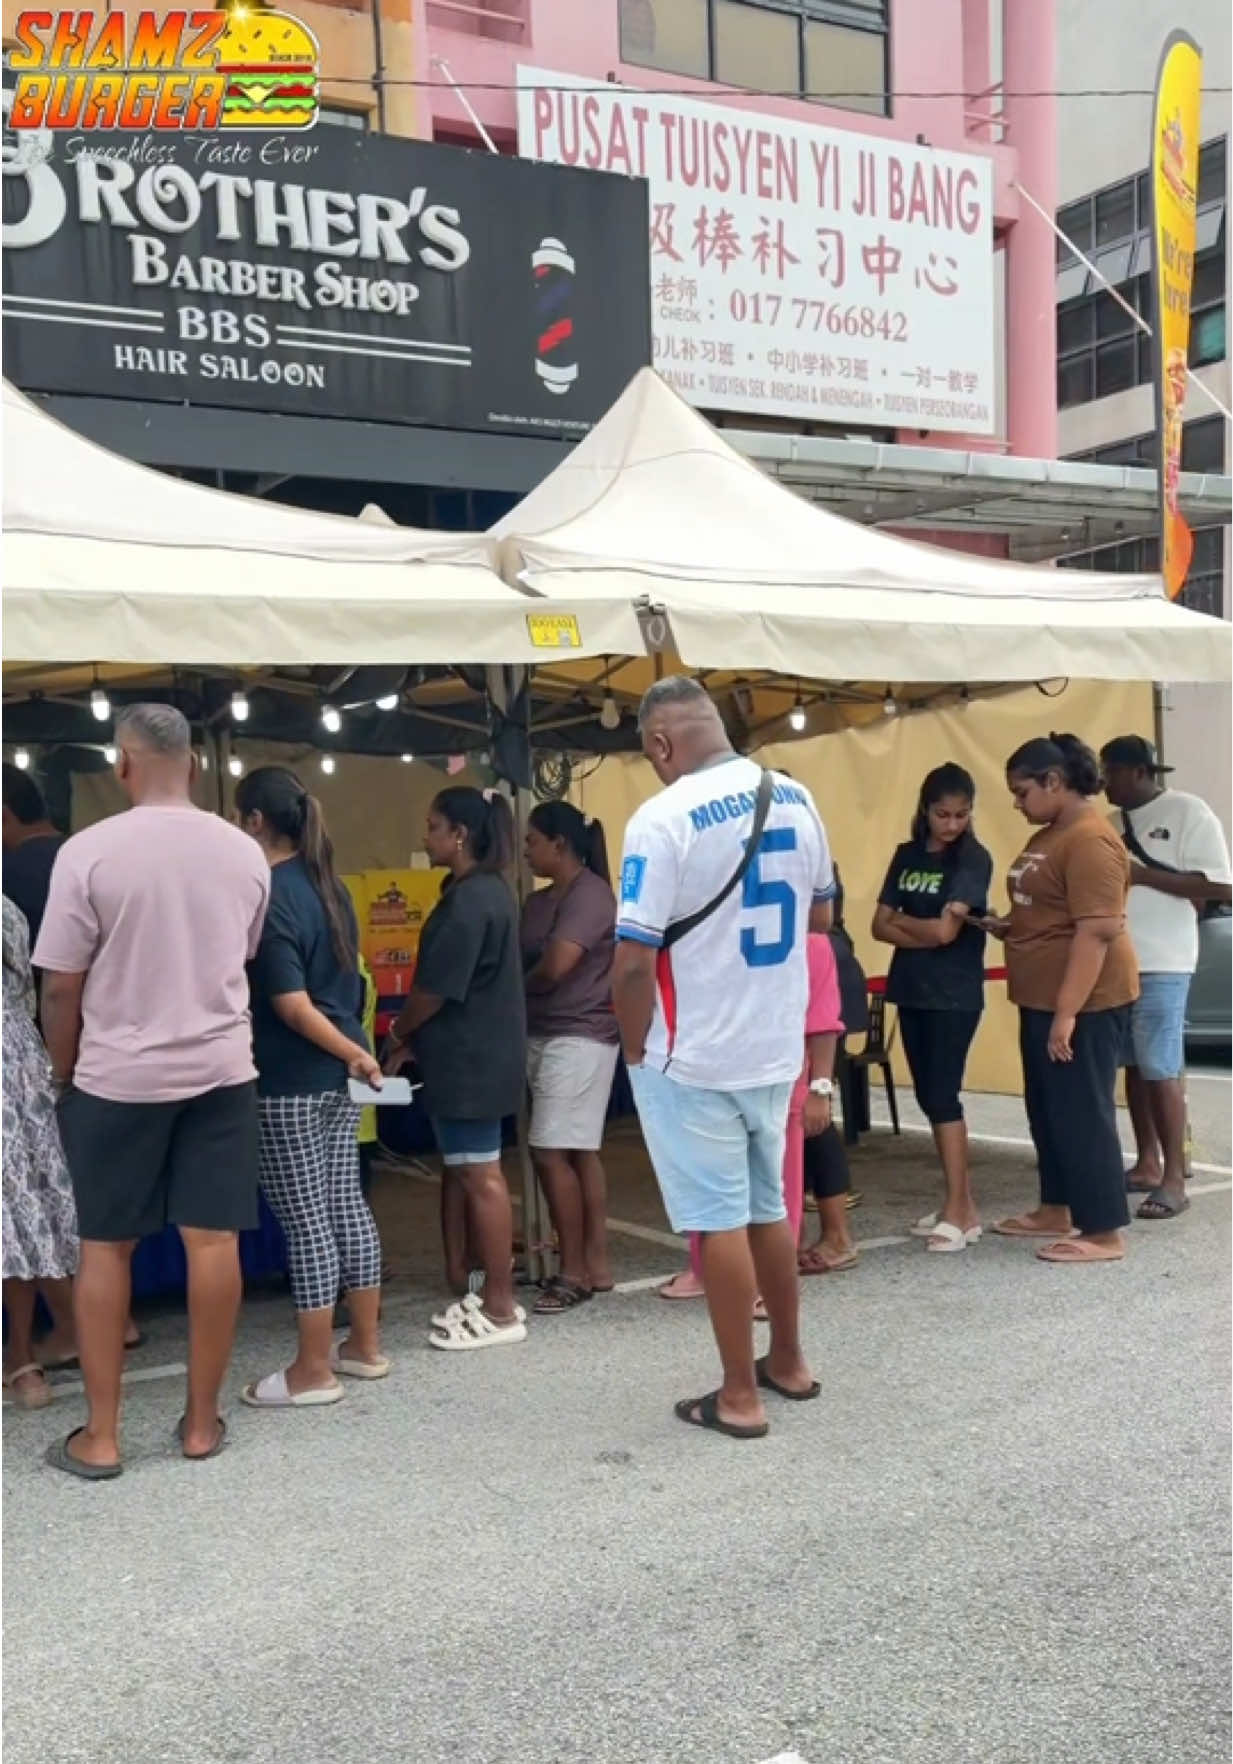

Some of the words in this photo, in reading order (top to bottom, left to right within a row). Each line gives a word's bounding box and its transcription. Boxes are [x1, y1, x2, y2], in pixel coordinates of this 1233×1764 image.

[534, 87, 649, 175] PUSAT
[659, 111, 799, 204] TUISYEN
[809, 141, 841, 211] YI
[851, 153, 876, 217] JI
[888, 156, 982, 236] BANG
[128, 234, 314, 309] BARBER
[314, 261, 419, 315] SHOP
[177, 307, 273, 348] BBS
[729, 288, 783, 327] 017
[791, 297, 908, 343] 7766842
[114, 345, 188, 376] HAIR
[200, 354, 326, 389] SALOON
[740, 827, 797, 968] 5
[898, 868, 944, 894] LOVE
